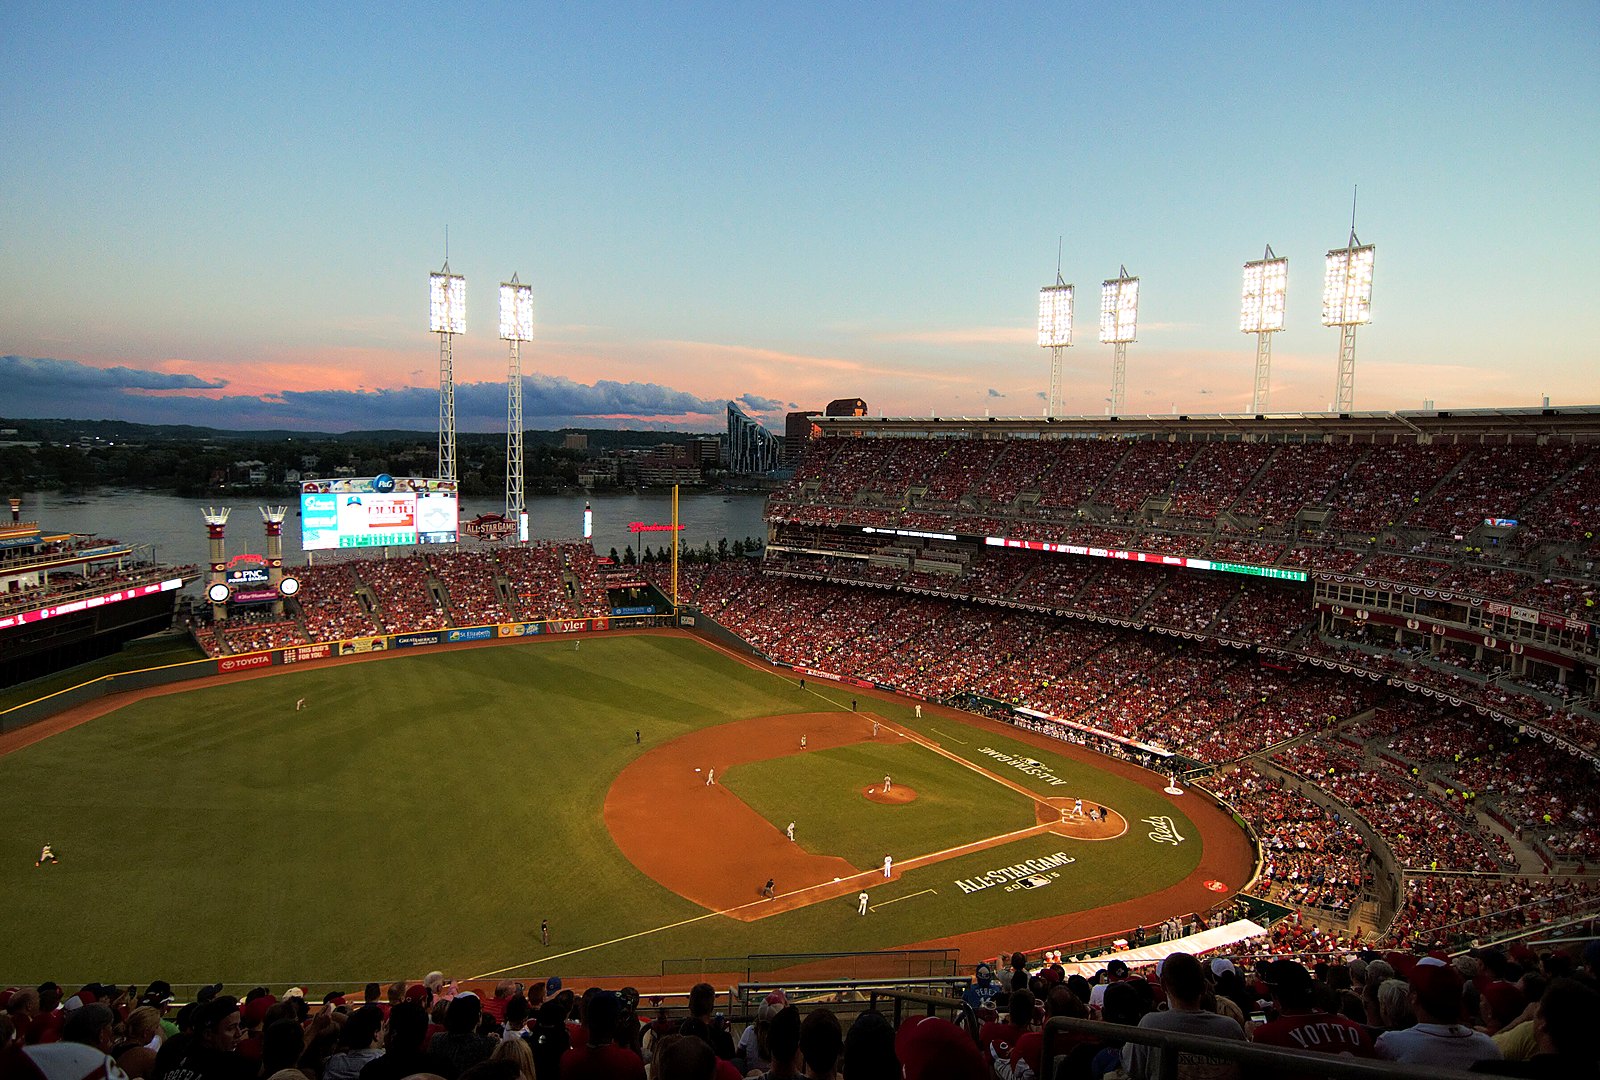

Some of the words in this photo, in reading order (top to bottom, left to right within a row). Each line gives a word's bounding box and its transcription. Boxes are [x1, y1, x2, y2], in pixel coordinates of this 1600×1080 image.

[378, 480, 393, 488] P&G
[498, 521, 516, 531] GAME
[242, 569, 263, 579] PNC
[299, 646, 311, 654] THIS
[236, 656, 269, 667] TOYOTA
[1141, 815, 1185, 846] Reds
[1025, 851, 1076, 872] GAME
[975, 988, 998, 997] PEREZ
[1288, 1022, 1360, 1048] VOTTO
